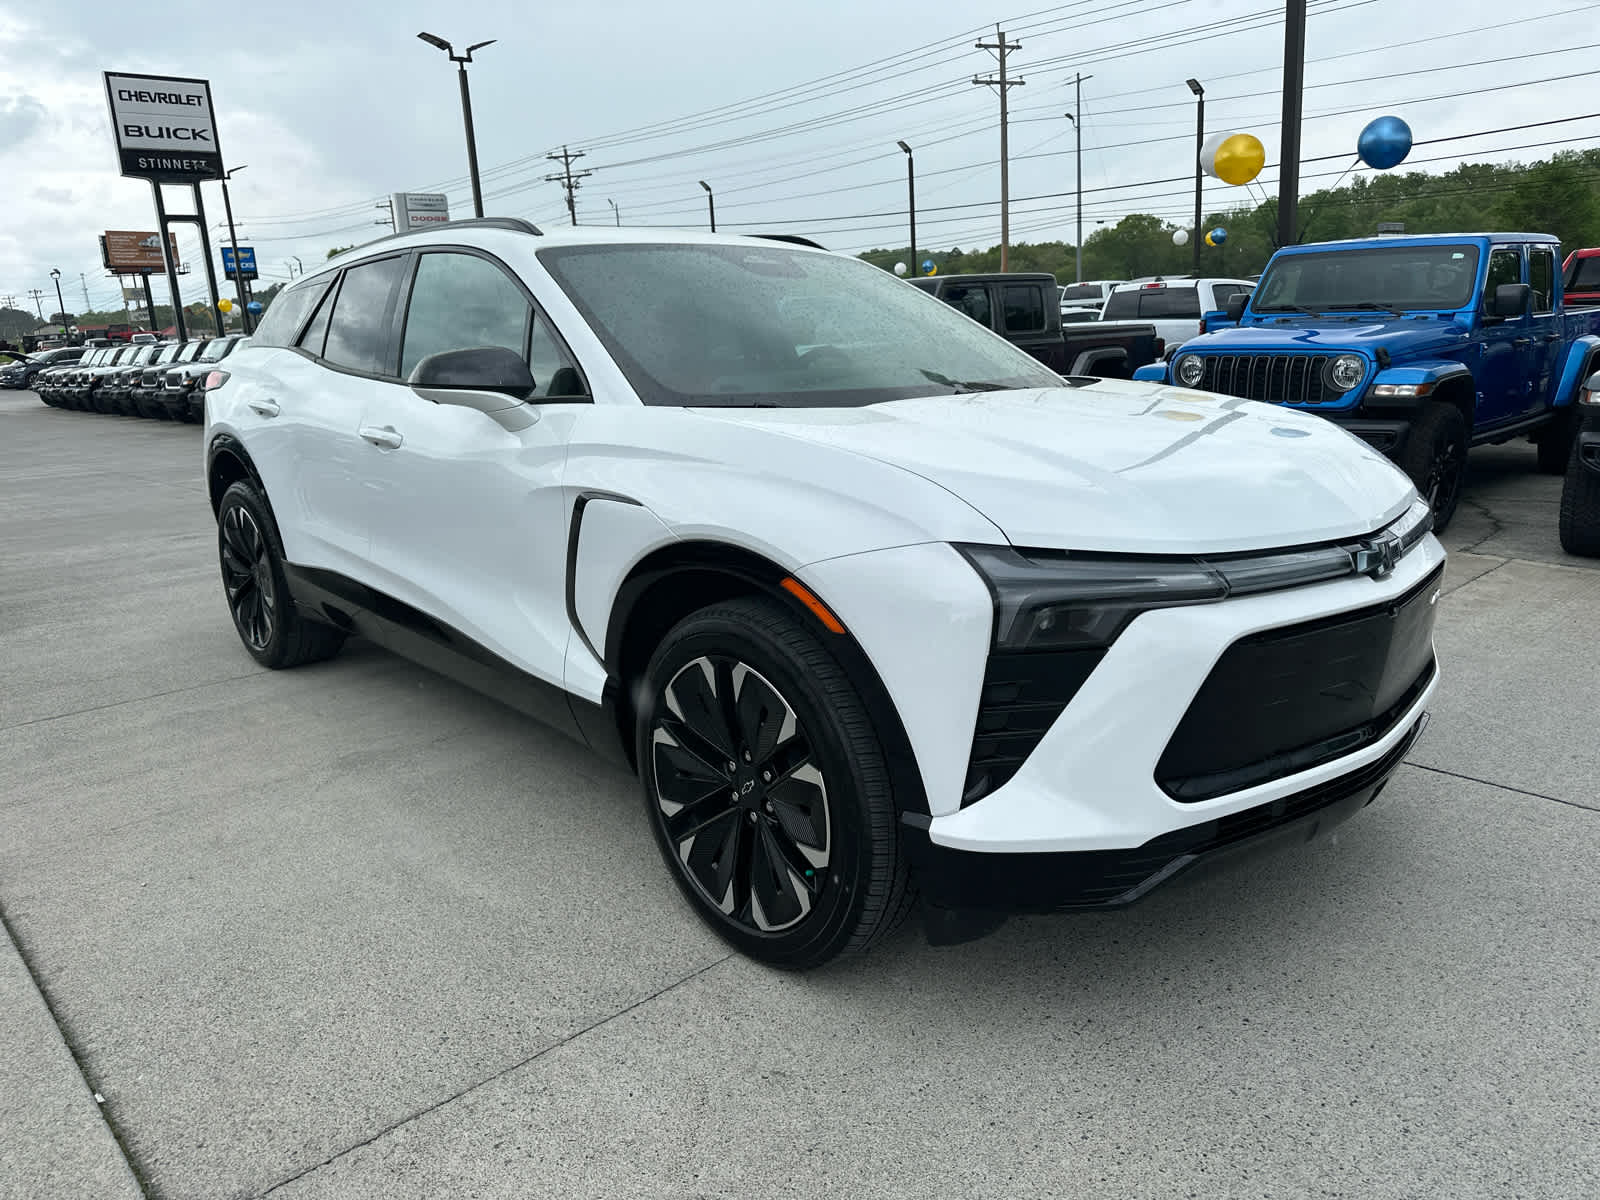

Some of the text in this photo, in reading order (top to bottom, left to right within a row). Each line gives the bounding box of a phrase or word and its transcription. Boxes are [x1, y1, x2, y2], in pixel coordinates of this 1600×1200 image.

[118, 89, 203, 107] CHEVROLET
[123, 124, 211, 141] BUICK
[138, 157, 207, 171] STINNETT
